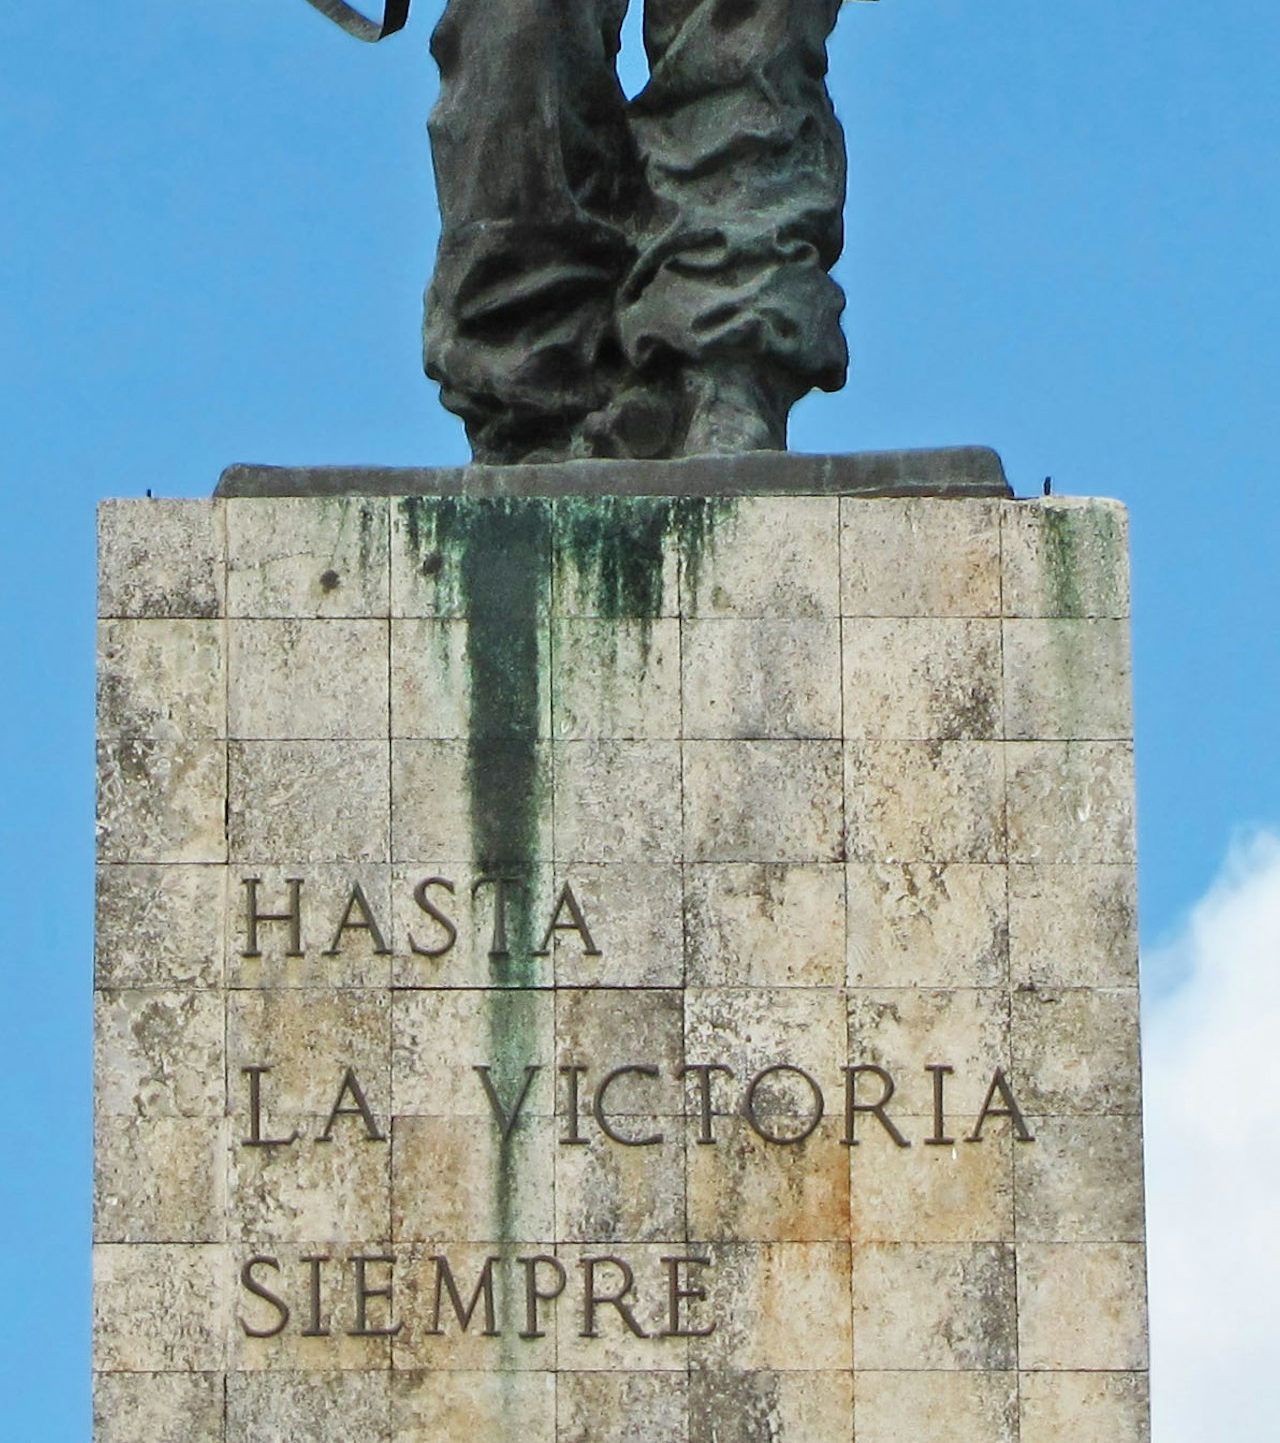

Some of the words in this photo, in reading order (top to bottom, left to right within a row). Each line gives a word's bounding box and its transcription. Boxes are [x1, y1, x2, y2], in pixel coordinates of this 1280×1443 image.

[240, 876, 602, 957] HASTA
[240, 1064, 386, 1147] LA
[473, 1063, 1036, 1147] VICTORIA
[239, 1254, 718, 1340] SIEMPRE
